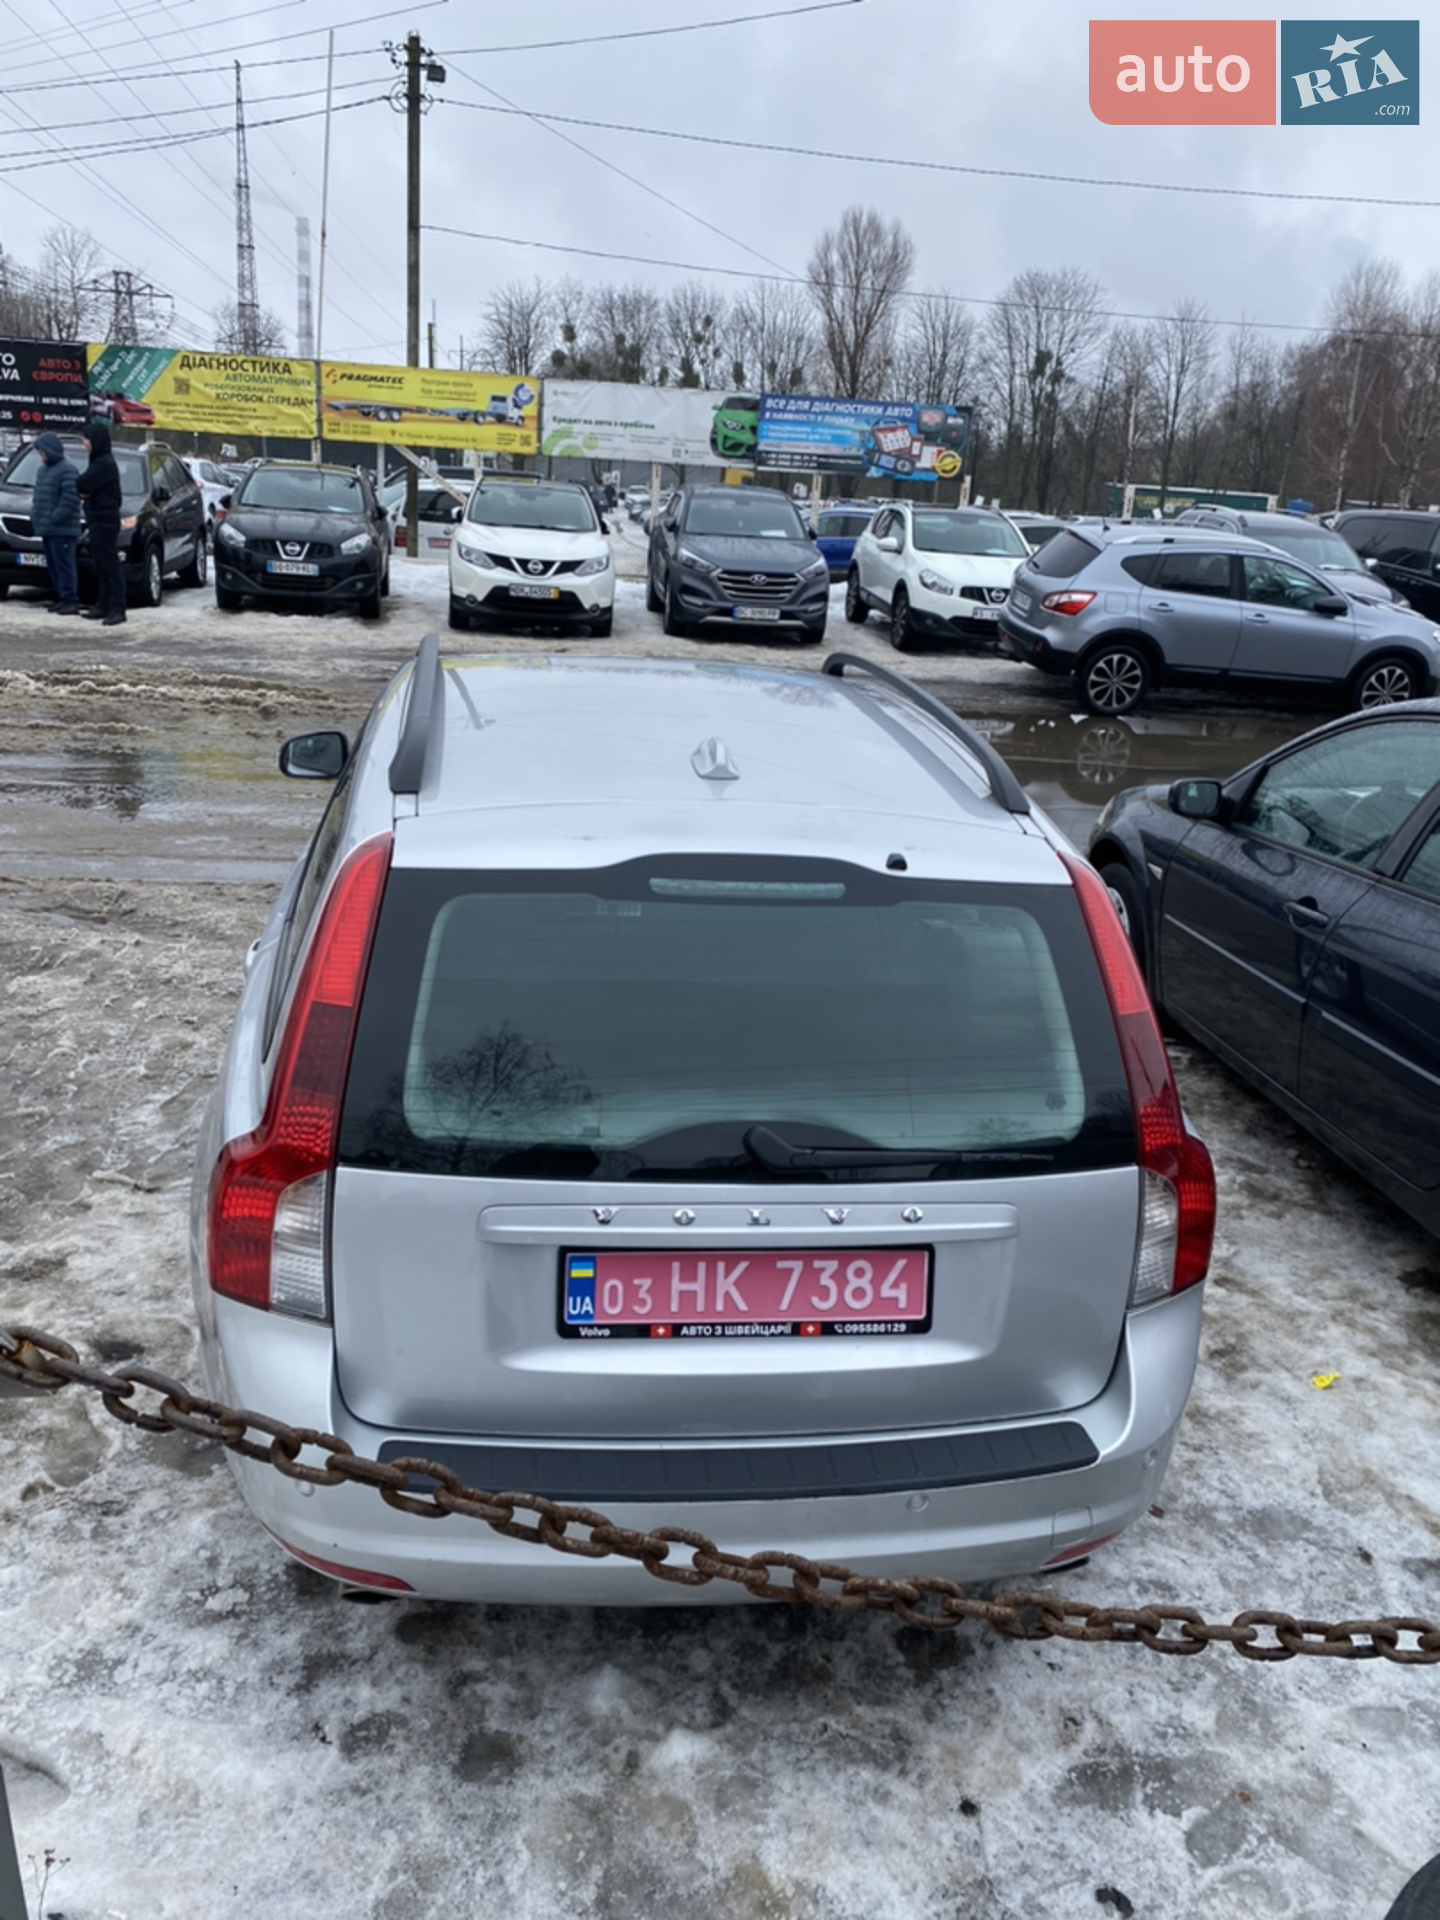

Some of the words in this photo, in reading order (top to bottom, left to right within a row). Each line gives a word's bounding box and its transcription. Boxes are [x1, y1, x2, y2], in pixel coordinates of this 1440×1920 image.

[39, 359, 72, 369] АВТО
[179, 355, 292, 375] ДІАГНОСТИКА
[214, 392, 264, 404] КОРОБОК
[267, 396, 313, 409] ПЕРЕДАЧ
[787, 400, 810, 411] ДЛЯ
[811, 401, 883, 414] ДІАГНОСТИКИ
[885, 406, 913, 418] АВТО
[552, 415, 581, 425] Кредит
[589, 1205, 925, 1227] VOLVO
[602, 1278, 653, 1316] 03
[669, 1261, 750, 1313] HK
[775, 1258, 909, 1312] 7384
[568, 1297, 594, 1315] UA
[579, 1327, 611, 1337] Volvo
[680, 1325, 713, 1336] АВТО
[724, 1322, 792, 1337] ШВЕЙЦАРІЇ
